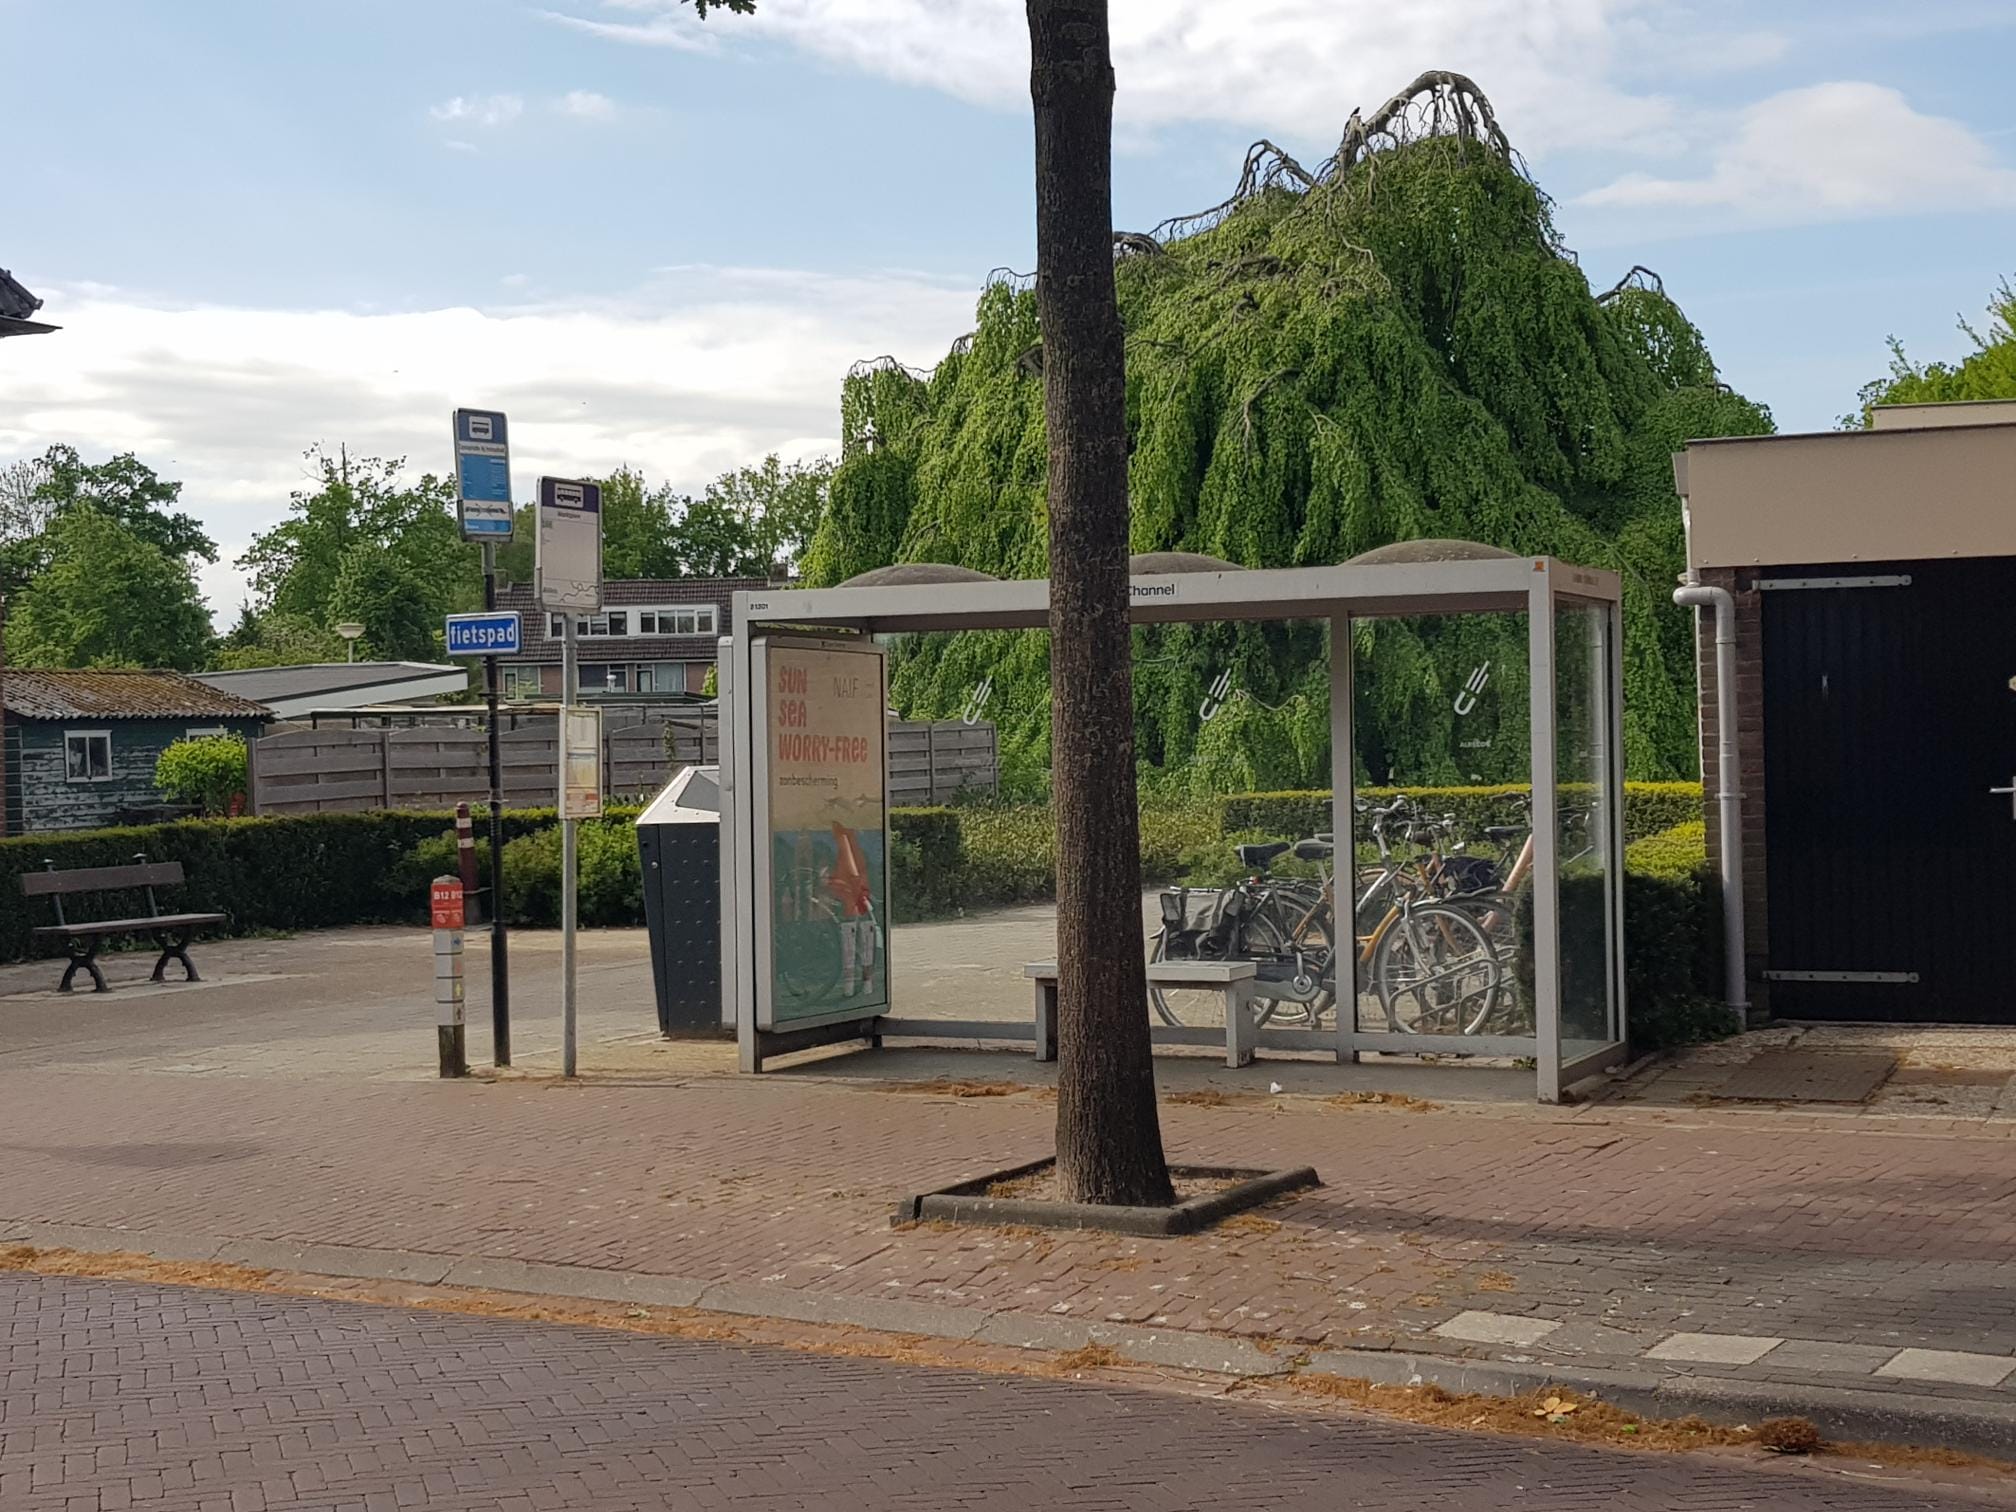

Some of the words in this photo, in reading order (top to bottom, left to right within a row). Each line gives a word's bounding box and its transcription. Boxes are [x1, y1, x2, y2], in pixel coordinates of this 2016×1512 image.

[450, 623, 515, 648] fietspad
[778, 665, 808, 695] SUN
[779, 773, 839, 790] zonbescherming
[434, 891, 450, 900] B12
